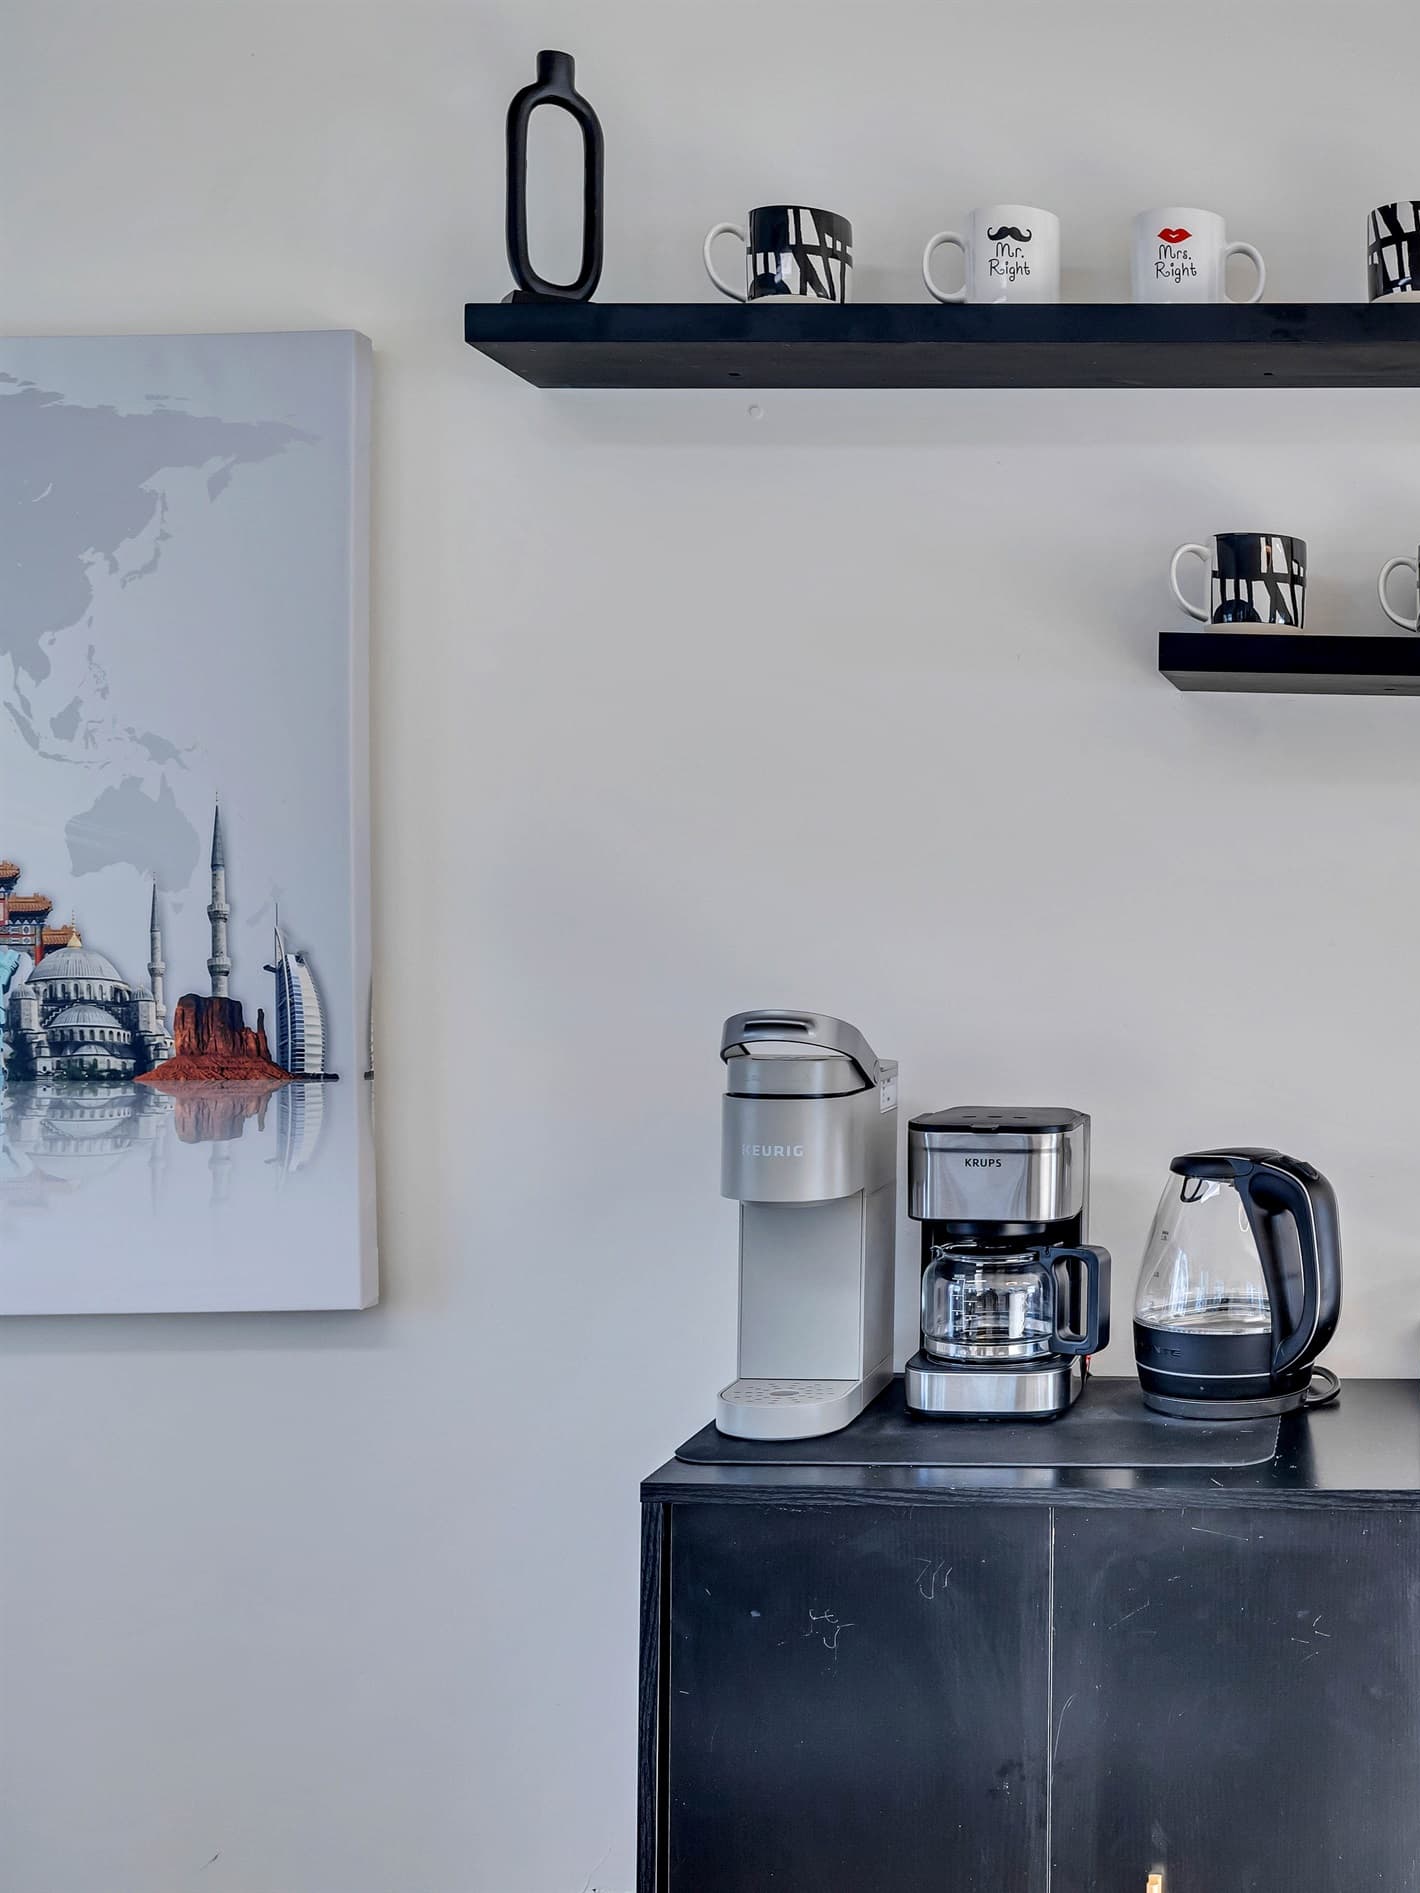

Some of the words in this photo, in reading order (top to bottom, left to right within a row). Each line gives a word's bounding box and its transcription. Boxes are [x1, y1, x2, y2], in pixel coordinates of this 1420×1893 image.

[996, 242, 1024, 258] Mr.
[1159, 244, 1191, 260] Mrs.
[988, 258, 1030, 281] Right
[1154, 261, 1197, 283] Right
[965, 1158, 1002, 1168] KRUPS
